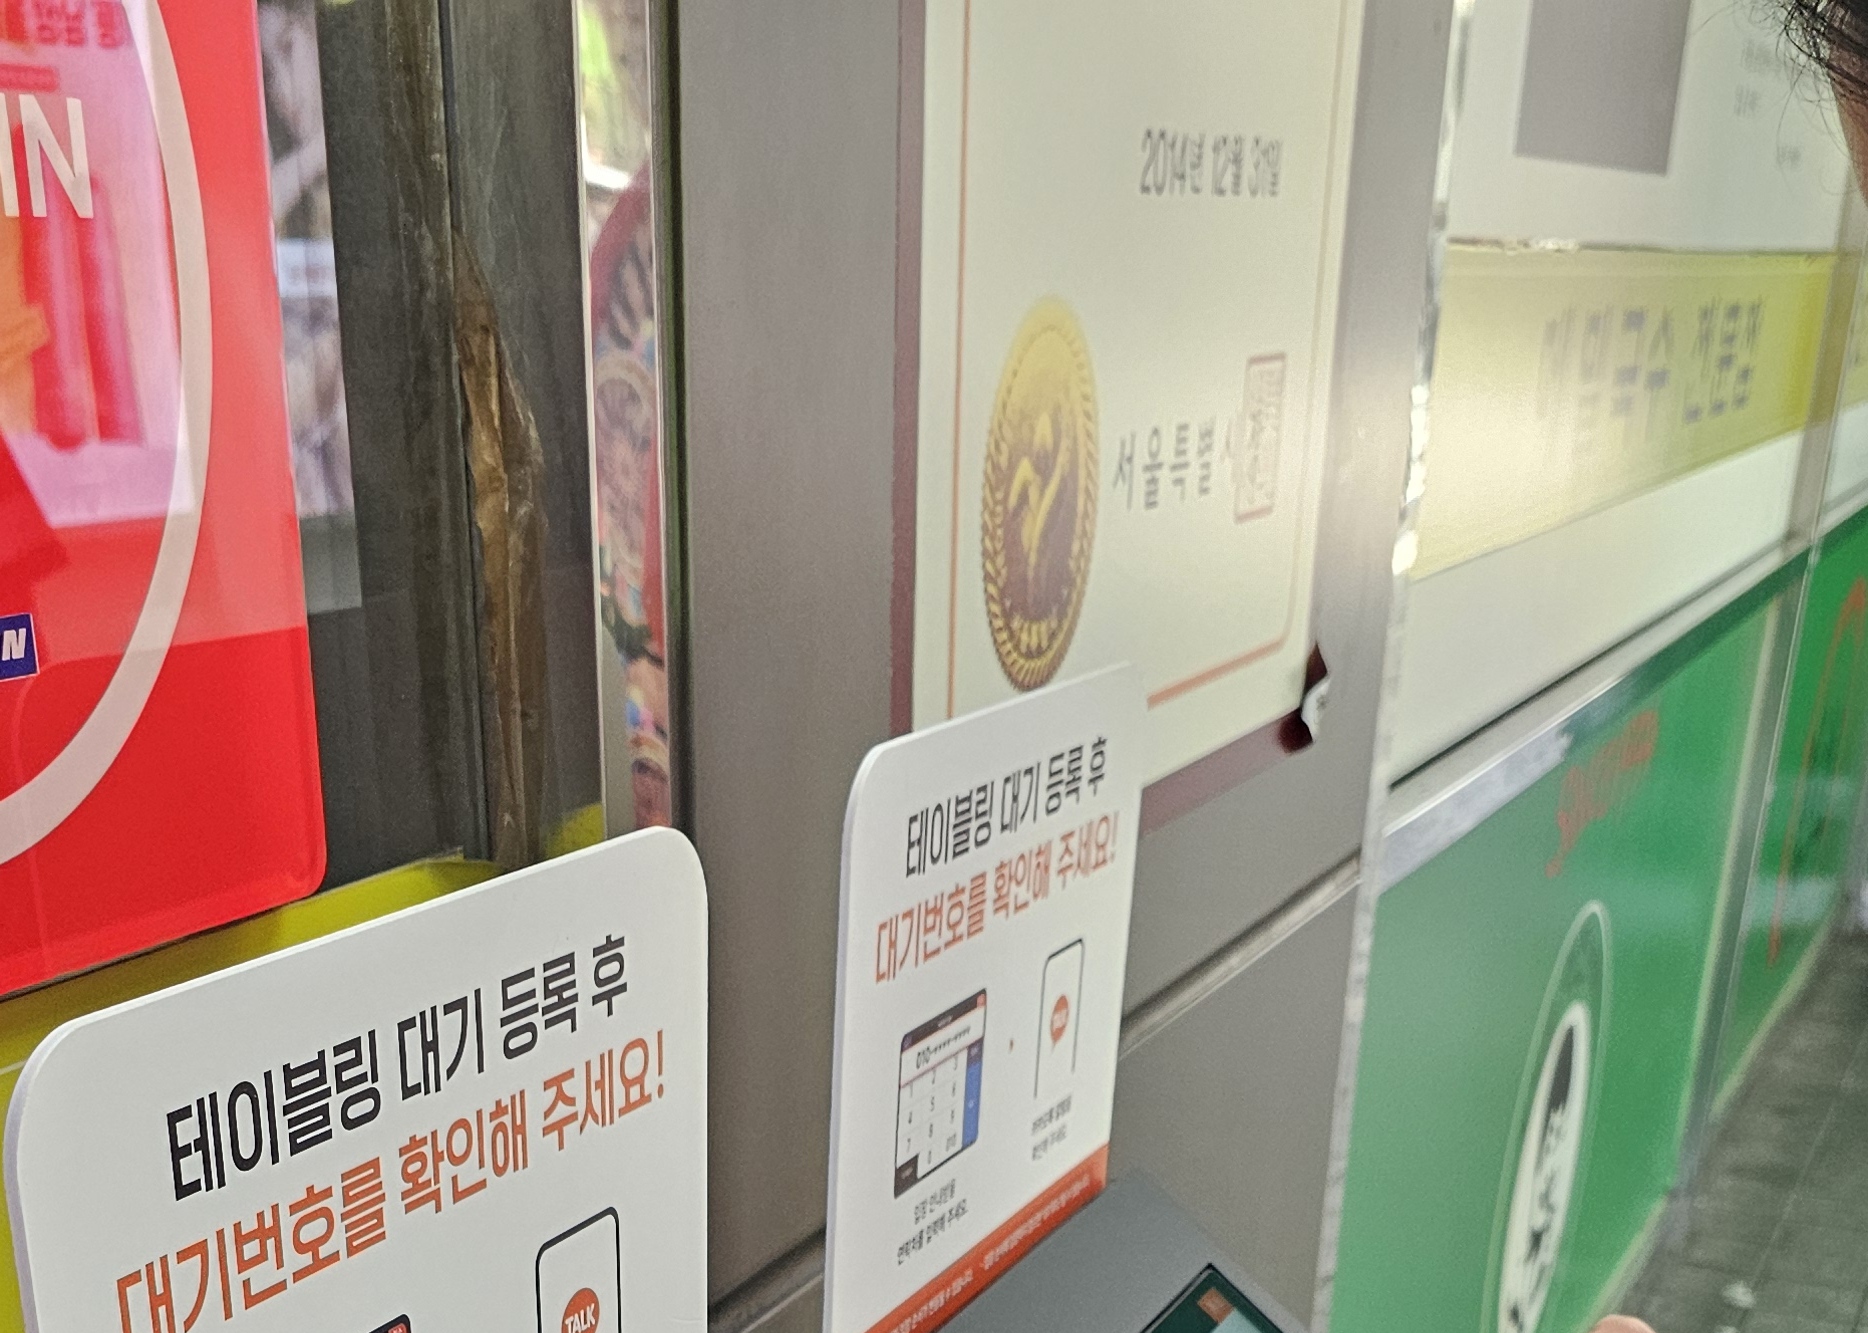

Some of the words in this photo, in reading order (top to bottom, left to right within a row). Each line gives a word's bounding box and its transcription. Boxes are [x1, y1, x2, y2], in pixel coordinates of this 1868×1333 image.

[875, 871, 988, 984] 대기번호를
[993, 839, 1053, 920] 확인해
[1057, 809, 1120, 890] 주세요!
[905, 780, 995, 878] 테이블링
[1000, 761, 1042, 836] 대기
[1045, 744, 1083, 817] 등록
[1088, 736, 1108, 797] 후
[166, 1029, 381, 1201] 테이블링
[397, 988, 485, 1101] 대기
[500, 951, 579, 1060] 등록
[592, 934, 628, 1018] 후
[398, 1089, 528, 1214] 확인해
[542, 1028, 664, 1152] 주세요!
